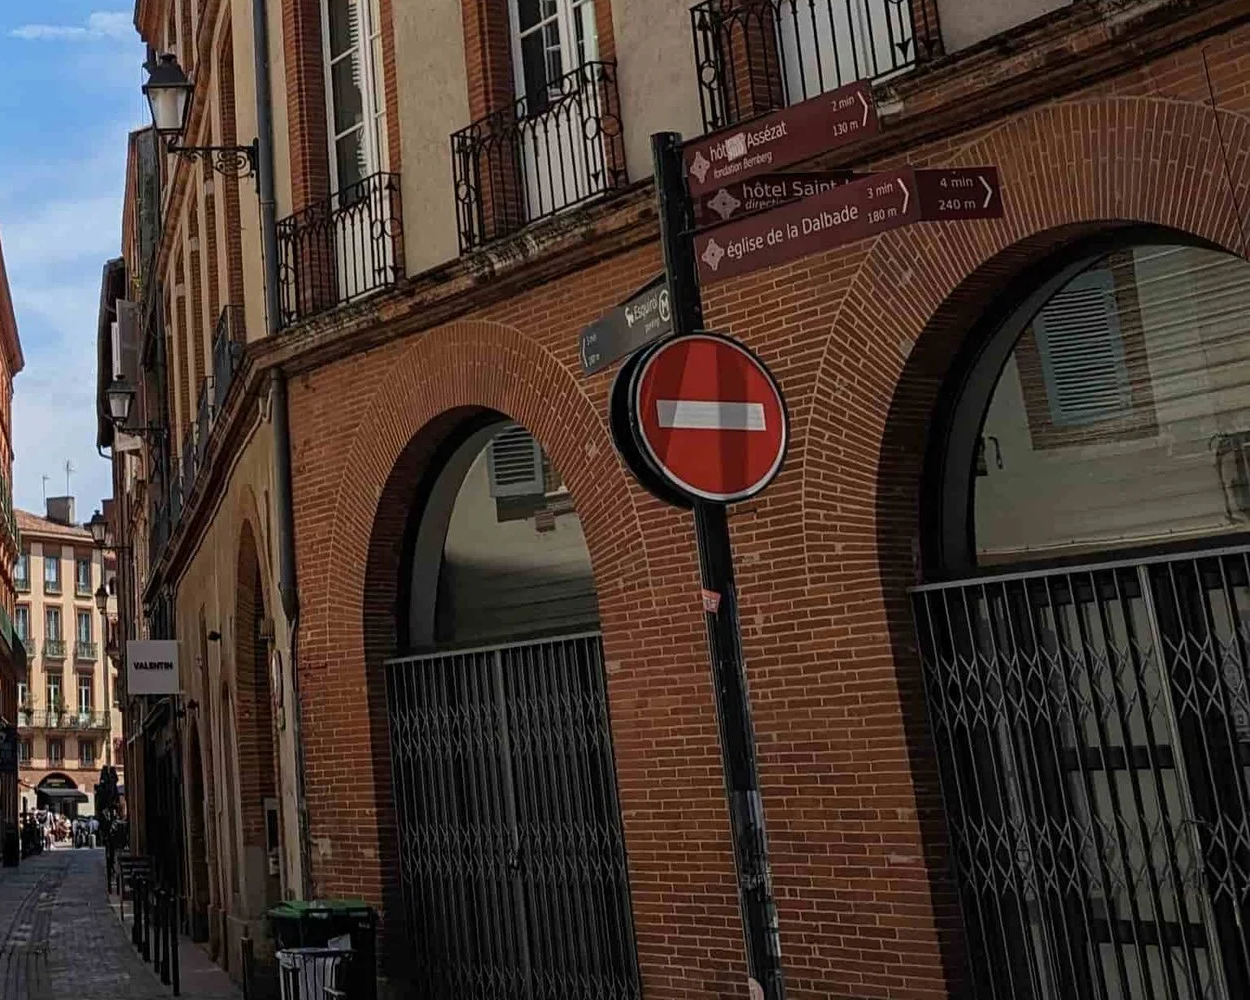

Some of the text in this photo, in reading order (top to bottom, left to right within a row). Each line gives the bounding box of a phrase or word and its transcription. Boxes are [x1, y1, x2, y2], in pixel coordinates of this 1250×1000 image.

[832, 95, 855, 111] 2 min
[833, 121, 858, 136] 130 m
[743, 181, 786, 198] hôtel
[940, 176, 974, 188] 4 min
[867, 182, 893, 199] 3 min
[939, 199, 976, 211] 240 m
[868, 207, 897, 223] 180 m
[727, 204, 859, 260] église de la Dalbade
[133, 661, 173, 670] VALENTIN
